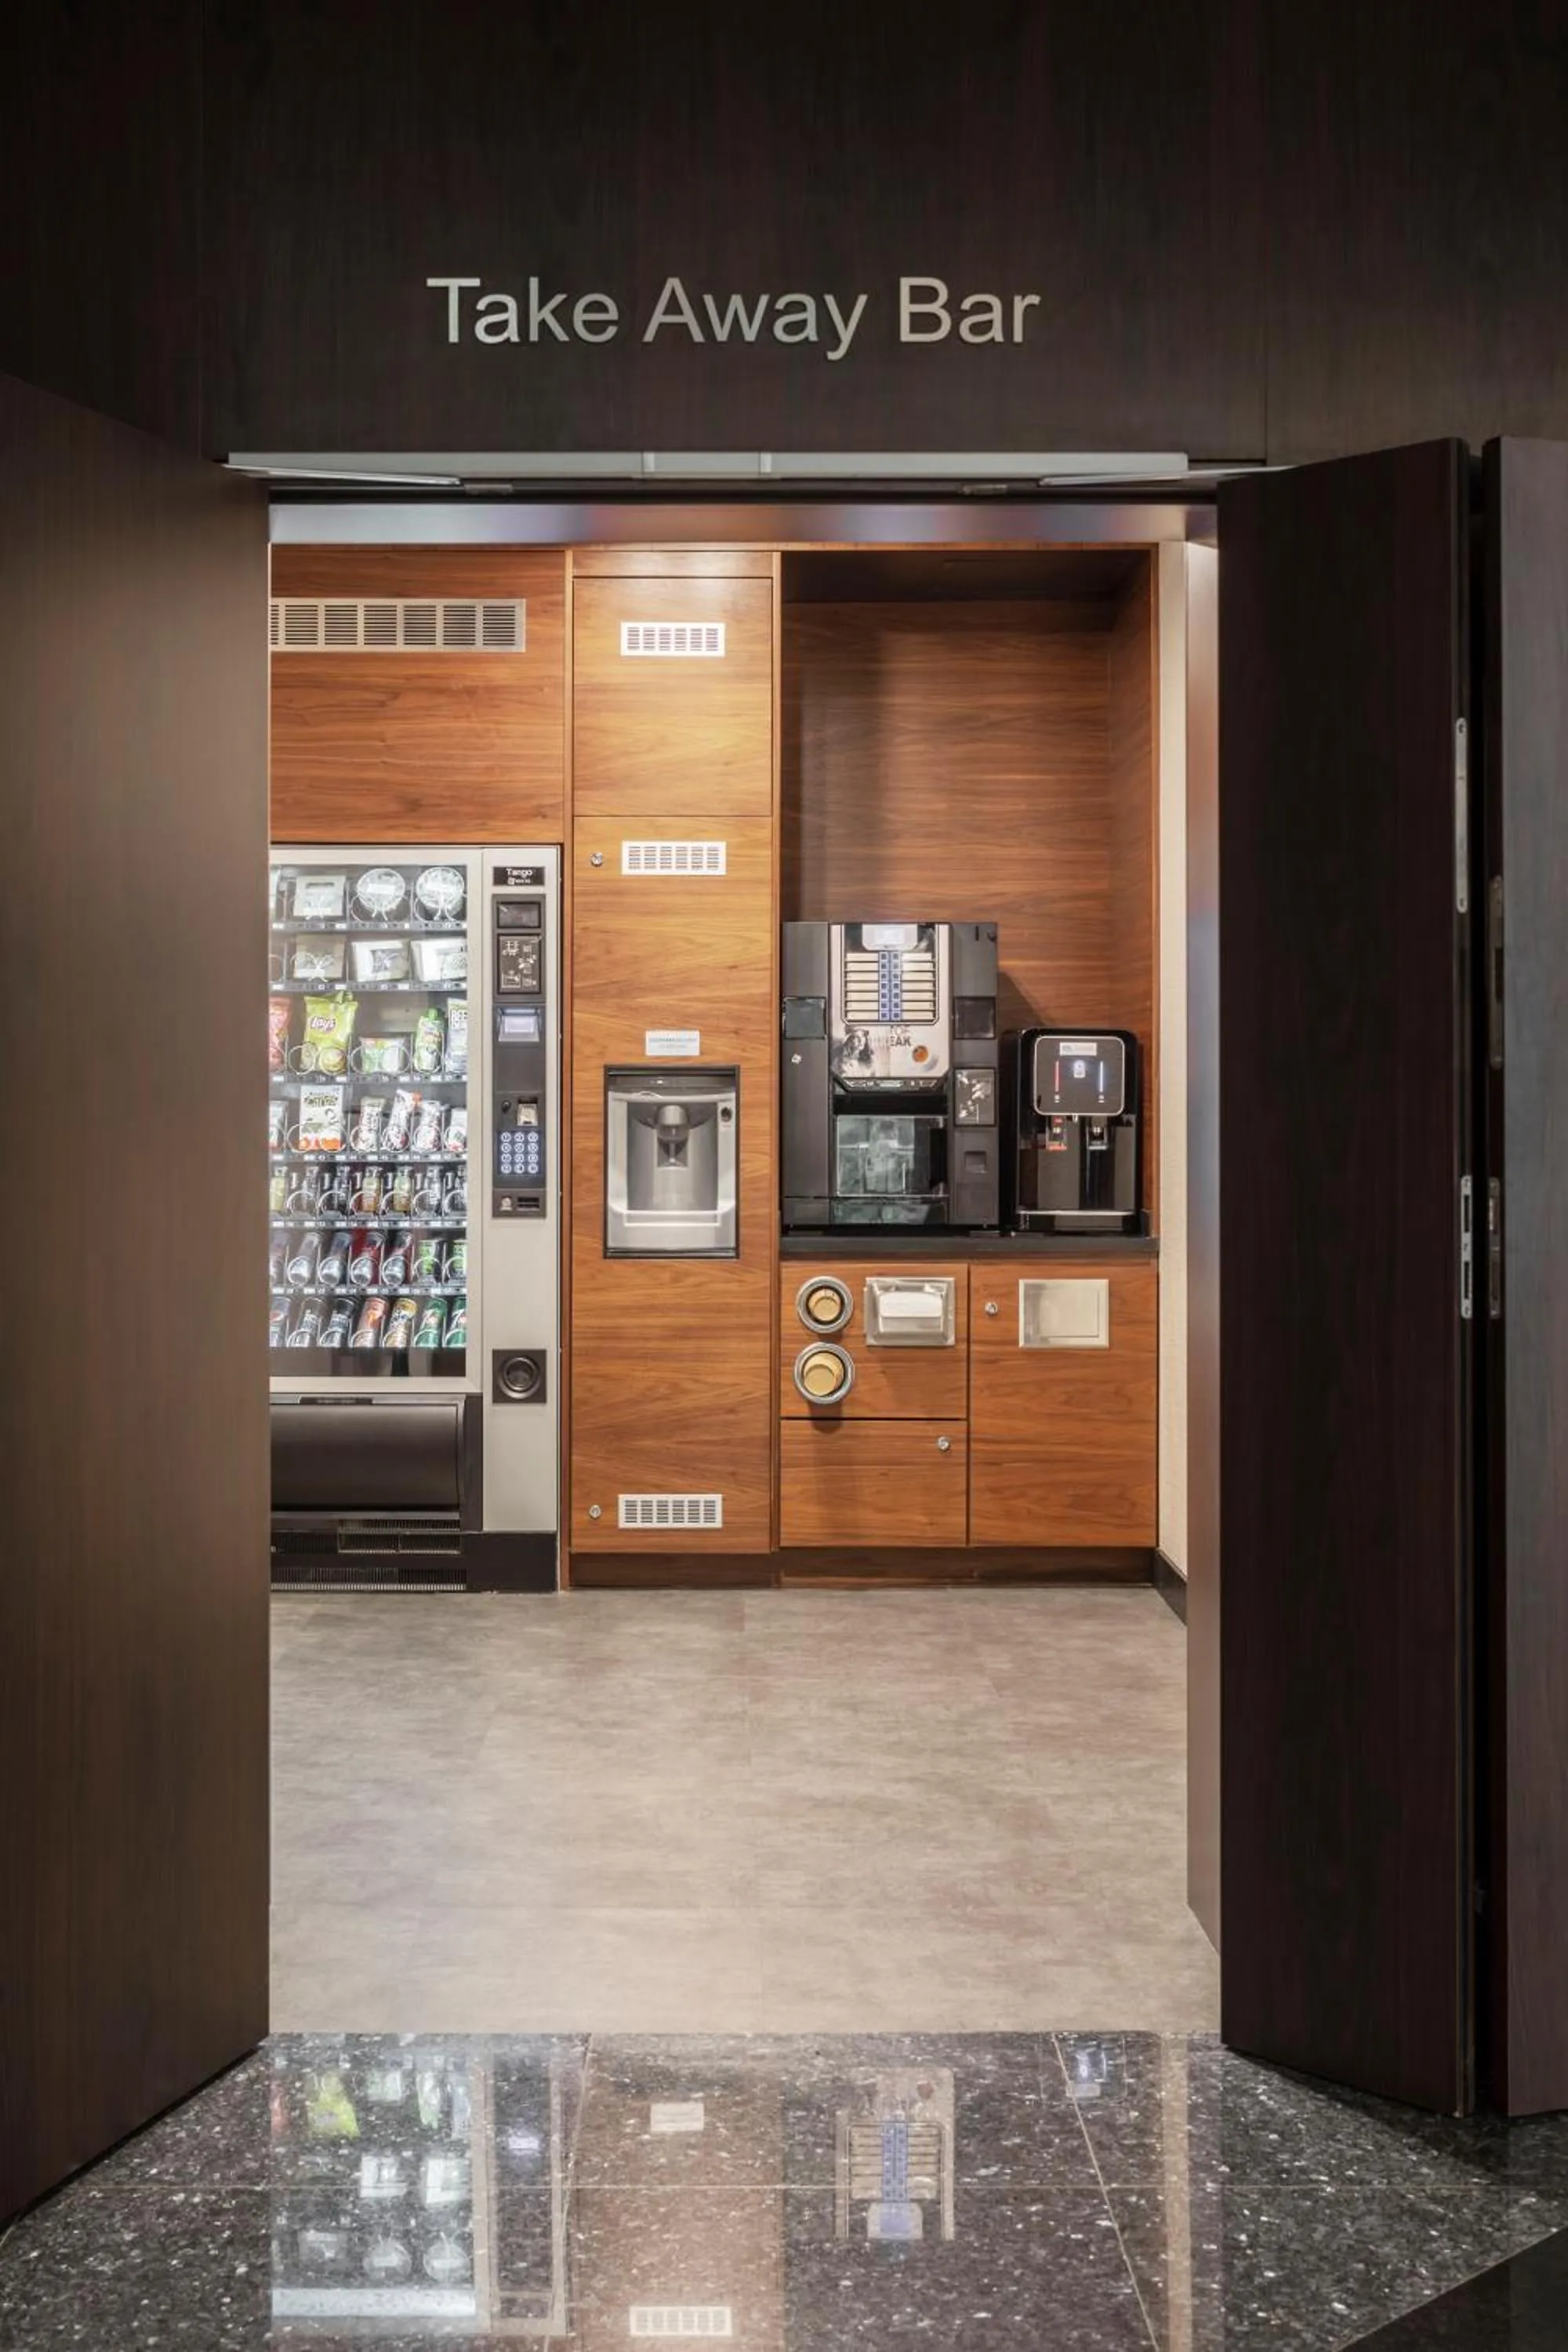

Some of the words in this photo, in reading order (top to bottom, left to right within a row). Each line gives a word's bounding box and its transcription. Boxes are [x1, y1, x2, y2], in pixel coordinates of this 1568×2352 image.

[426, 277, 619, 344] Take
[643, 277, 868, 361] Away
[899, 277, 1041, 343] Bar
[506, 868, 533, 878] Tango
